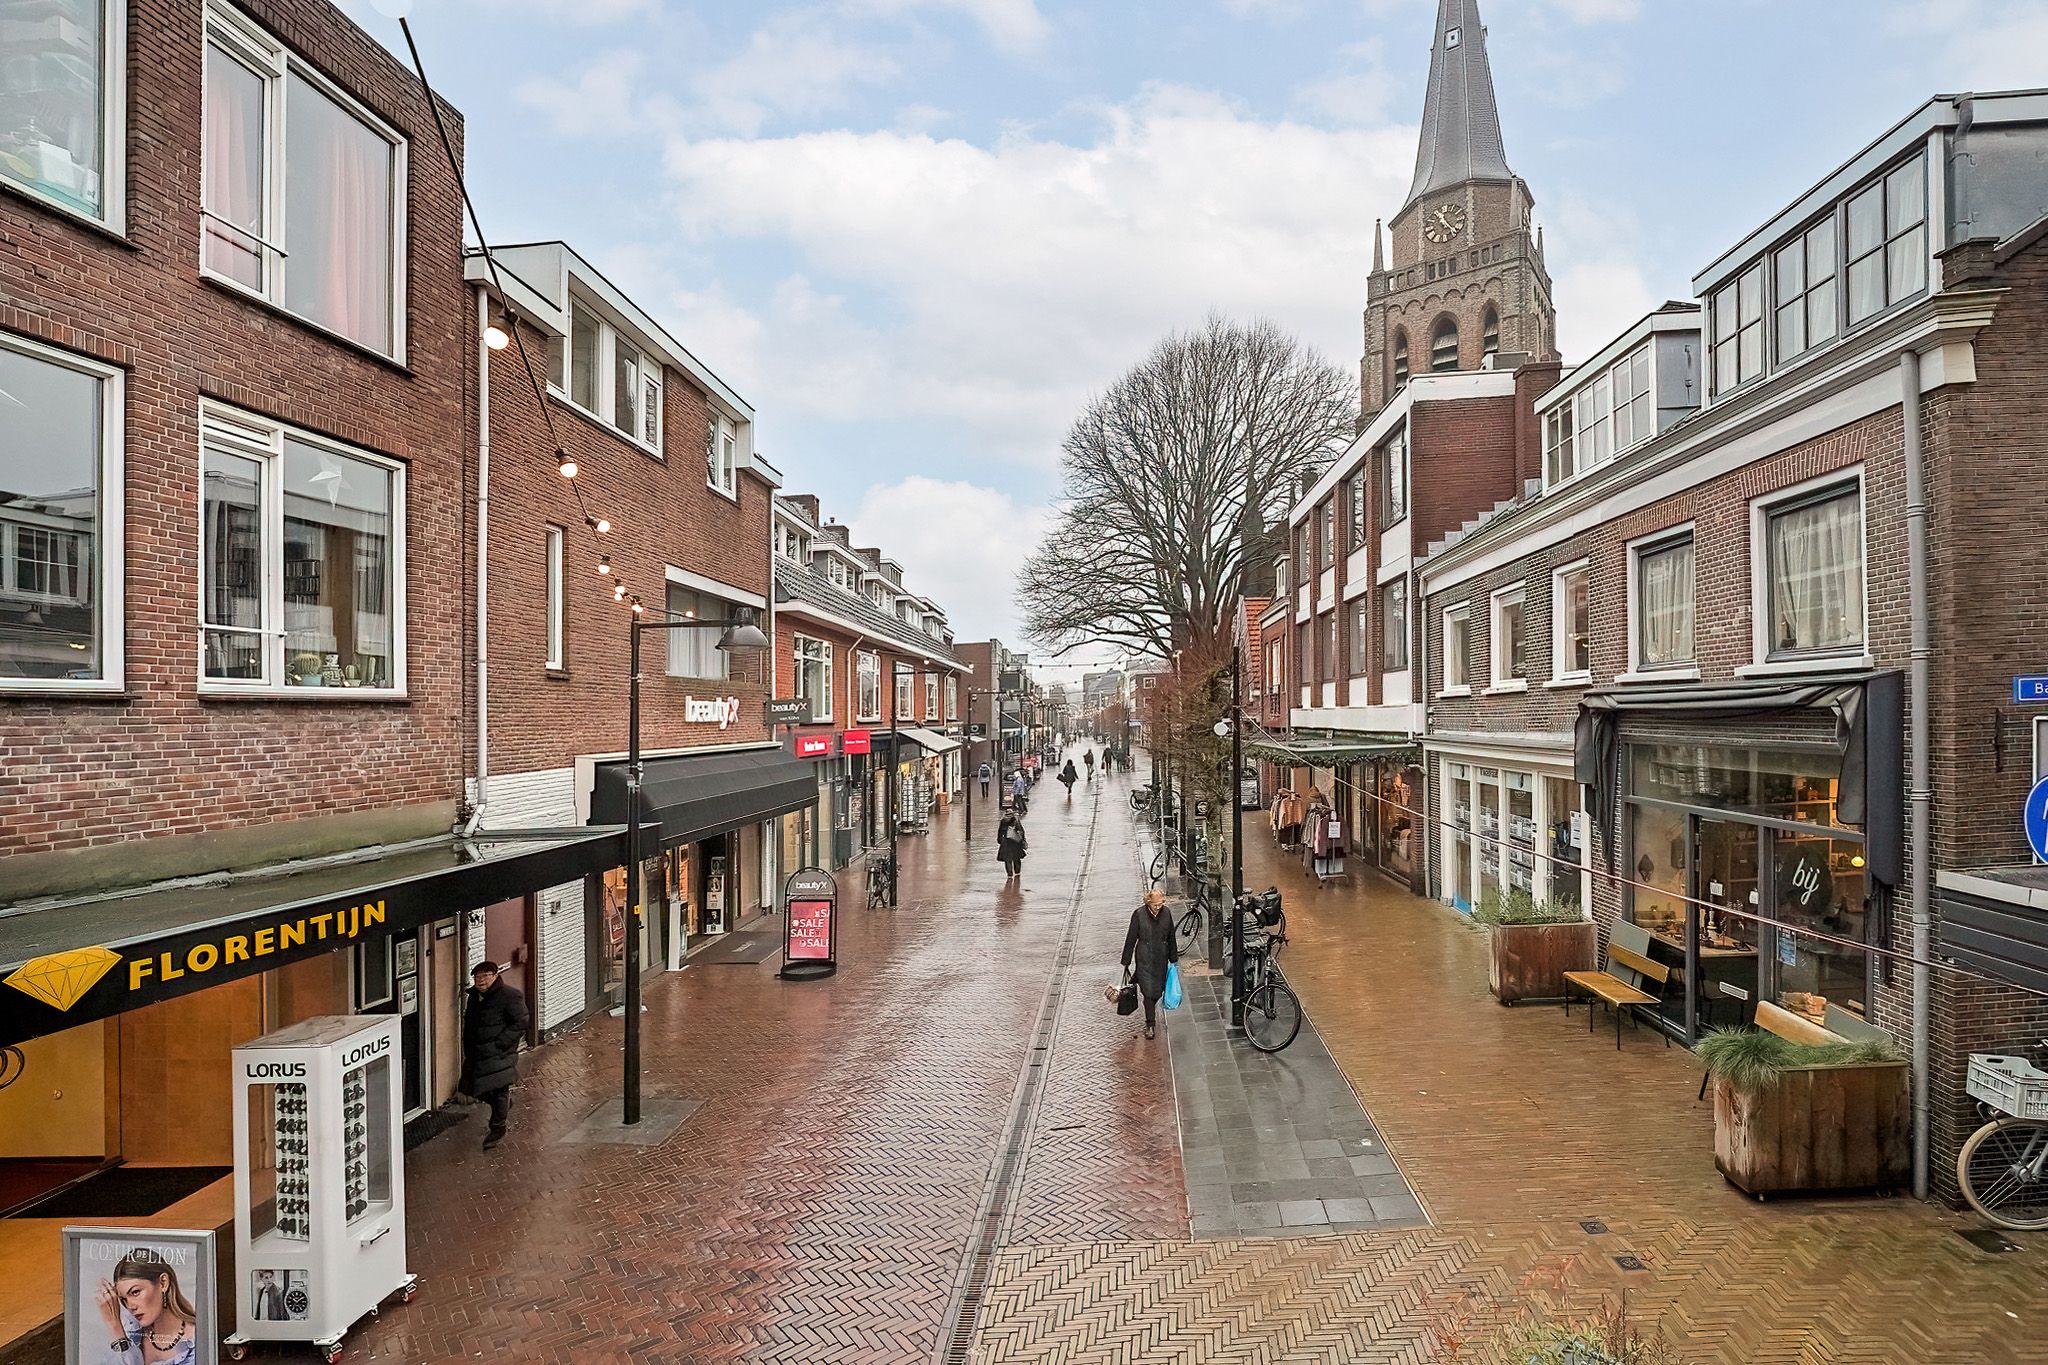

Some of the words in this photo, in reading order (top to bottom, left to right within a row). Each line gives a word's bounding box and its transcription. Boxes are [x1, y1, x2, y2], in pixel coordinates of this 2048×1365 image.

[1792, 857, 1820, 906] bij
[790, 928, 815, 938] SALE
[799, 918, 824, 928] SALE
[129, 900, 385, 990] FLORENTIJN
[342, 1035, 390, 1067] LORUS
[246, 1063, 306, 1077] LORUS
[147, 1245, 187, 1265] LION
